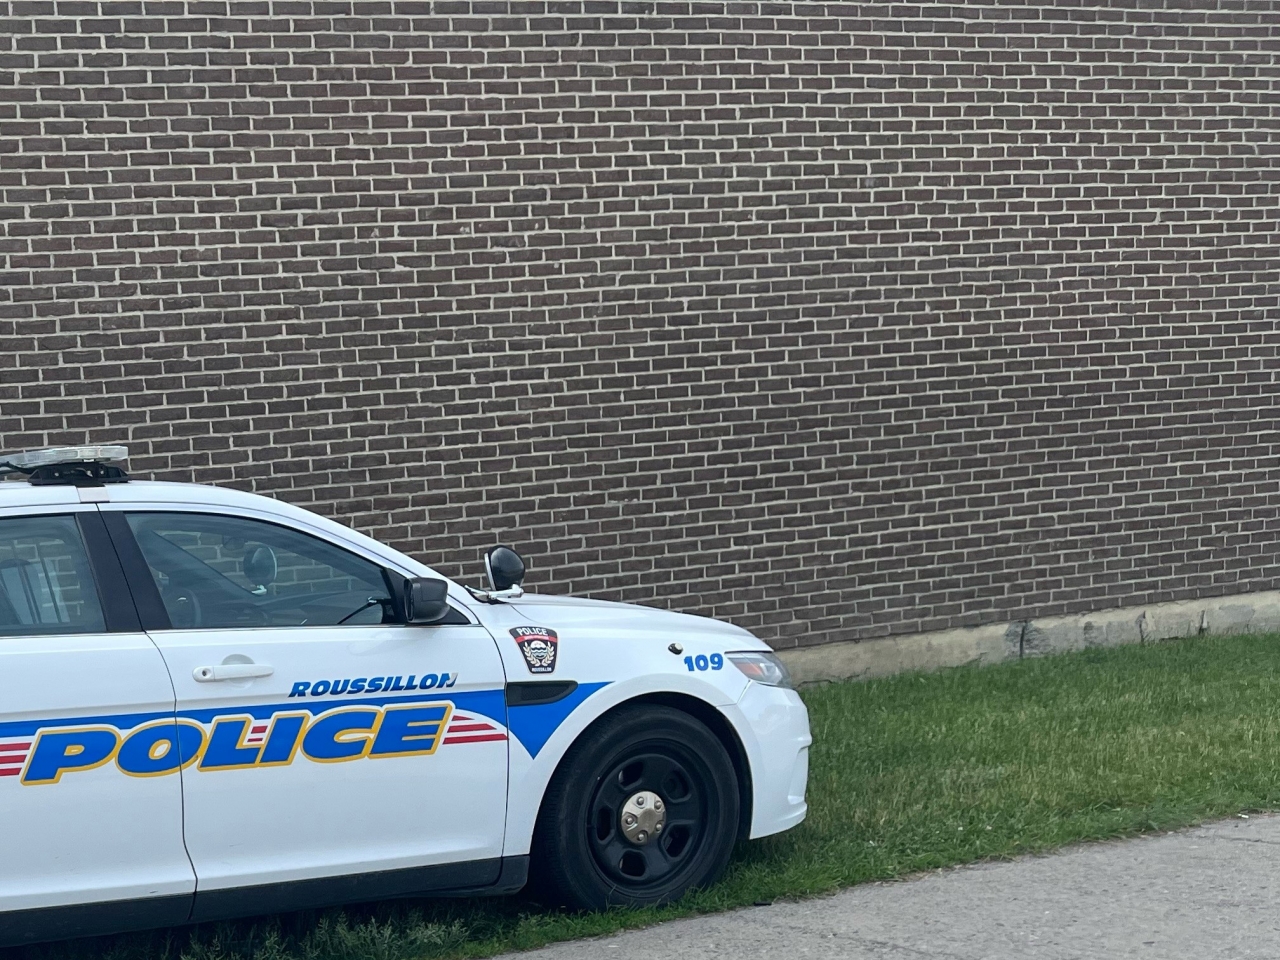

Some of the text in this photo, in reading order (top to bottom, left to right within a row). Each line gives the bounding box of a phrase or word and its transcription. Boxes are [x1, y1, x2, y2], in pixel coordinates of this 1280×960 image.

[516, 627, 549, 636] POLICE
[684, 653, 724, 672] 109
[288, 672, 458, 698] ROUSSILLON
[20, 702, 455, 785] POLICE
